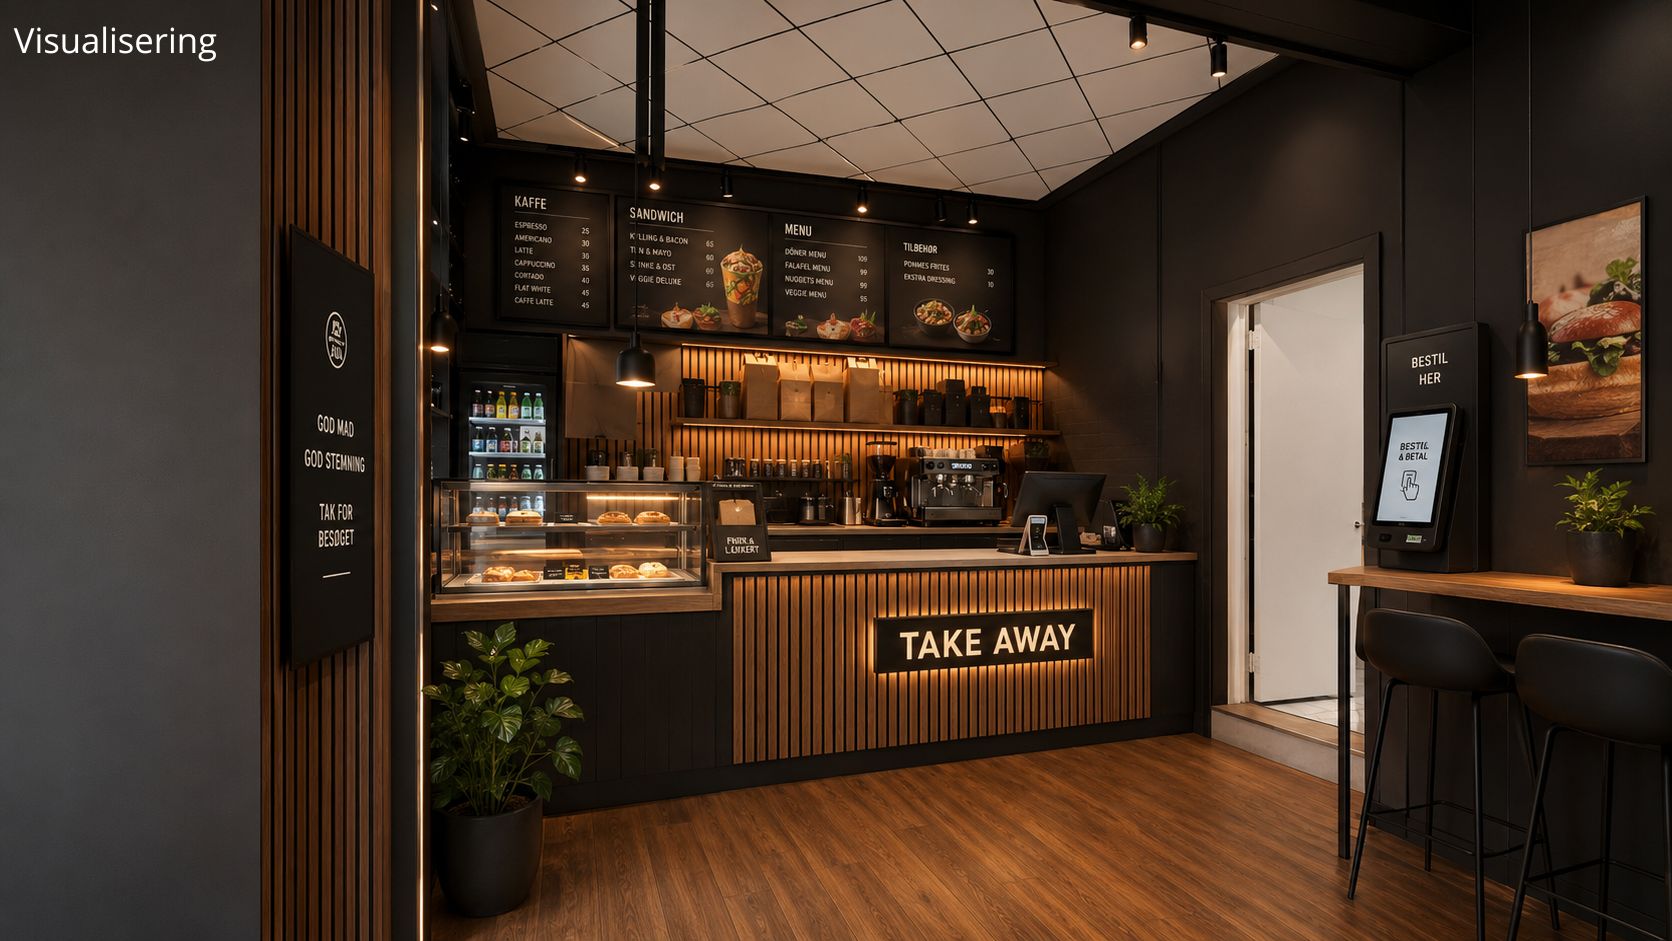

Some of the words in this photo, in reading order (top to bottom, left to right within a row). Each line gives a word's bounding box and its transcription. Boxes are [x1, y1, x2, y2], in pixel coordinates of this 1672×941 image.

[514, 195, 547, 210] KAFFE
[629, 207, 684, 223] SANDWICH
[514, 221, 548, 231] ESPRESSO
[582, 227, 590, 235] 25
[785, 223, 812, 236] MENU
[514, 234, 553, 244] AMERICANO
[582, 240, 590, 248] 30
[630, 232, 658, 242] KLLING
[666, 236, 689, 245] BACON
[706, 240, 714, 248] 65
[514, 246, 534, 255] LATTE
[582, 252, 590, 260] 30
[646, 248, 651, 256] &
[652, 248, 672, 258] MAYO
[808, 250, 826, 258] MENU
[514, 259, 556, 269] CAPPUCCINO
[630, 260, 654, 270] SINKE
[662, 263, 676, 271] OST
[784, 261, 811, 270] FALAFEL
[812, 264, 830, 272] MENU
[903, 260, 930, 270] POMMES
[930, 262, 950, 272] FRITES
[987, 268, 995, 276] 30
[514, 272, 545, 281] CORTADO
[630, 274, 654, 284] VGGIE
[655, 276, 682, 286] DELUXE
[784, 276, 814, 284] NUGGETS
[816, 278, 834, 286] MENU
[903, 273, 926, 282] EKSTRA
[926, 275, 956, 285] DRESSING
[514, 284, 530, 293] FLAT
[530, 285, 552, 294] WHITE
[784, 288, 808, 297] VEGGIE
[808, 290, 826, 298] MENU
[514, 296, 534, 306] CAFFE
[536, 298, 554, 306] LATTE
[1411, 352, 1449, 369] BESTIL
[1419, 372, 1442, 386] HER
[317, 414, 335, 434] GOD
[337, 418, 354, 438] MAD
[304, 449, 324, 469] GOD
[325, 451, 366, 473] STEMNING
[1406, 452, 1428, 460] BETAL
[320, 503, 336, 520] TAK
[338, 504, 354, 520] FOR
[318, 529, 354, 548] BESØGET
[899, 628, 982, 660] TAKE
[992, 623, 1076, 655] AWAY
